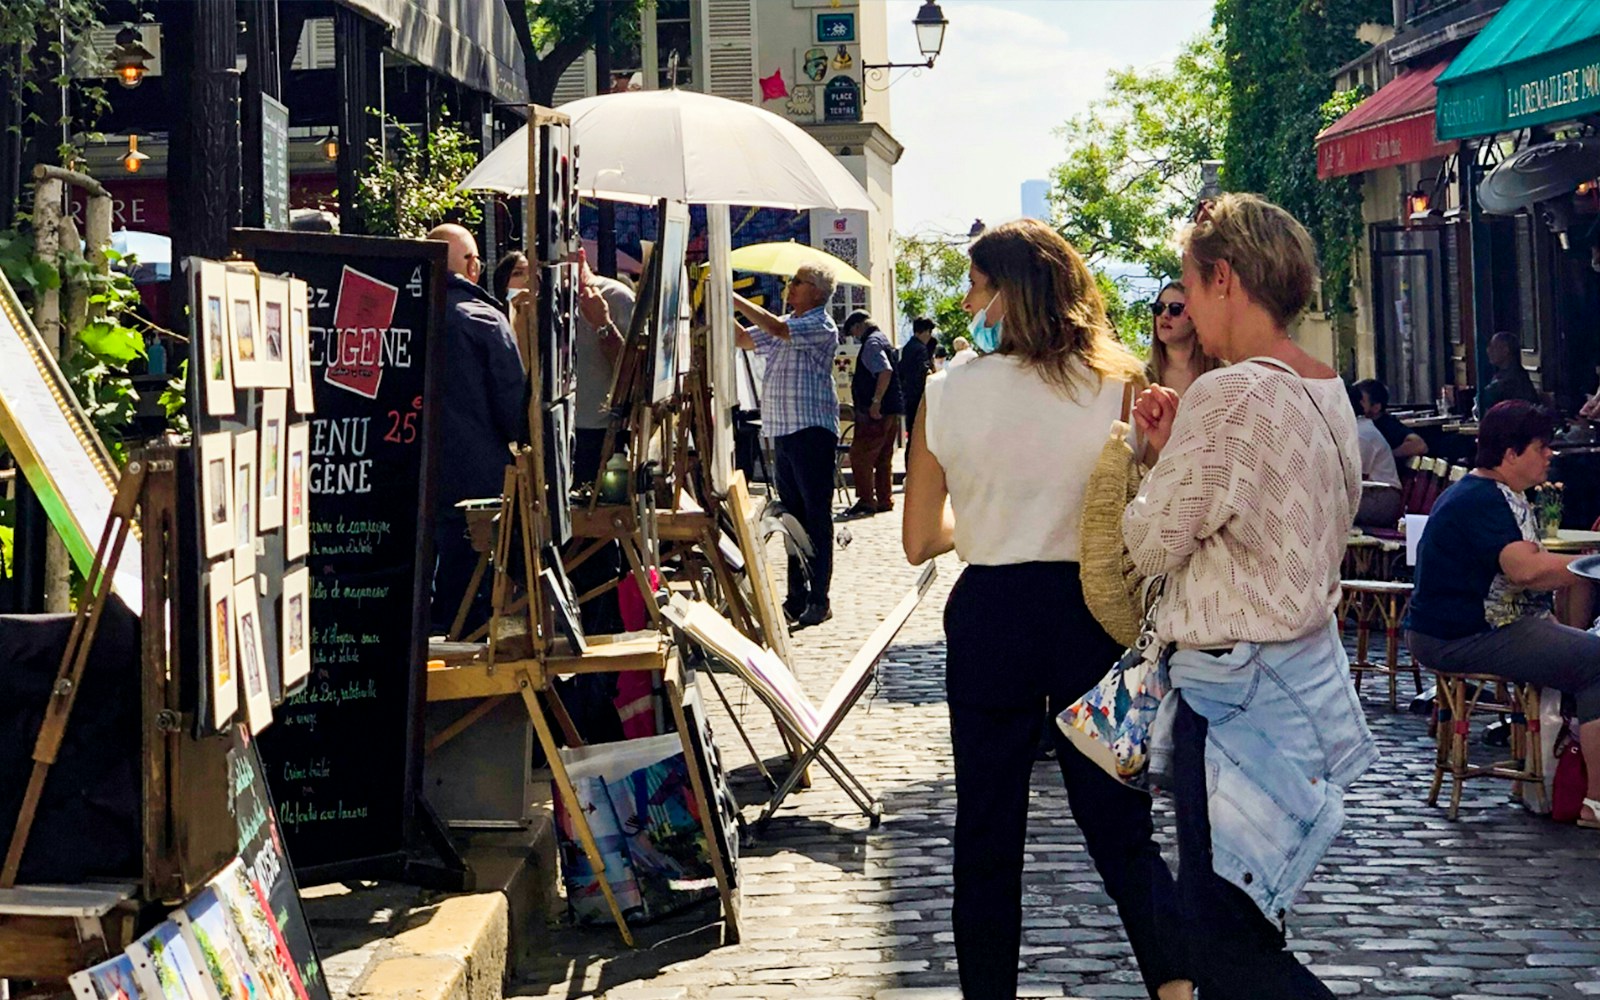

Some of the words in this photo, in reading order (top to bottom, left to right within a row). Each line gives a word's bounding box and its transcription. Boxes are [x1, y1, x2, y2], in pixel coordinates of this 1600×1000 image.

[831, 93, 853, 101] PLACE
[1508, 87, 1519, 117] LA
[311, 416, 371, 457] ENU
[308, 457, 373, 495] GÈNE
